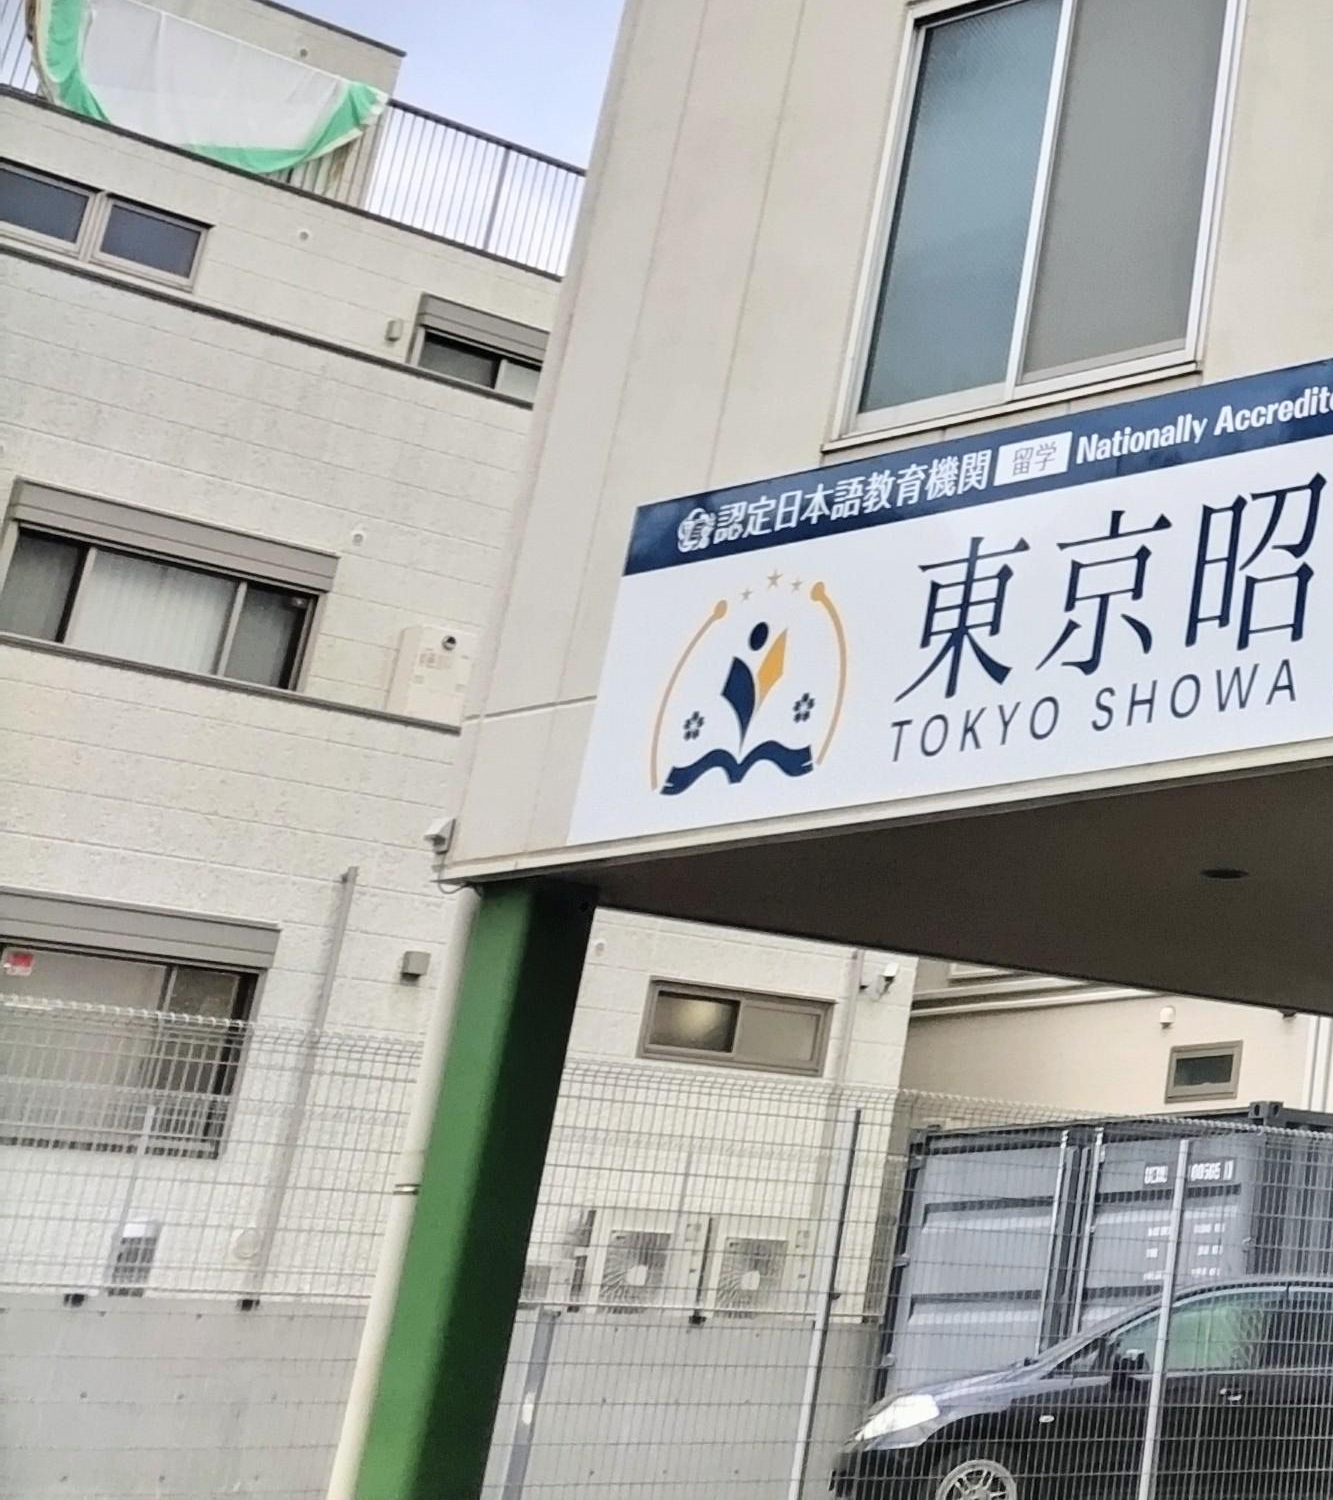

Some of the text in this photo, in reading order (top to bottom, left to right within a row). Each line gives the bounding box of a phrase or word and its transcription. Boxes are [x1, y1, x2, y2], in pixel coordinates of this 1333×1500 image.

[1077, 414, 1208, 464] Nationally
[713, 444, 1058, 543] 認定日本語教育機関 留学
[892, 697, 1059, 761] TOKYO
[1092, 659, 1295, 731] SHOWA
